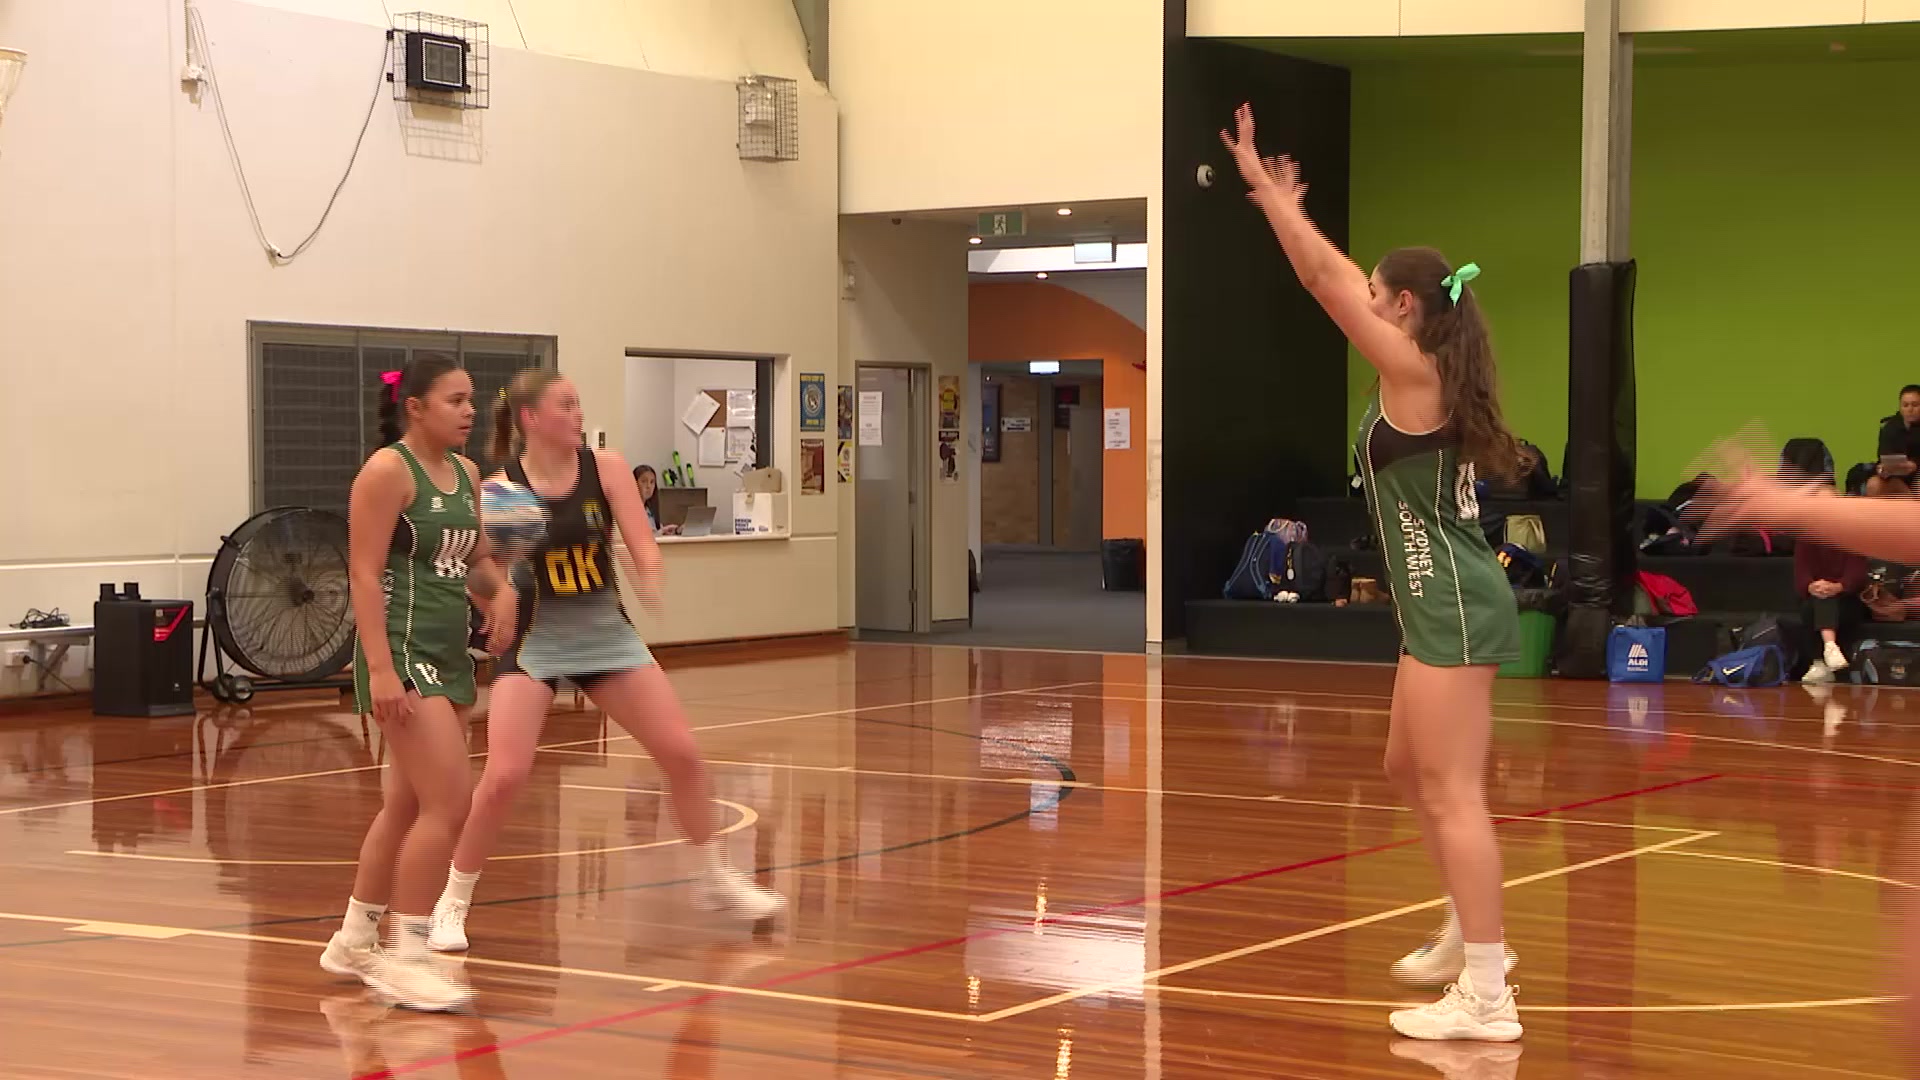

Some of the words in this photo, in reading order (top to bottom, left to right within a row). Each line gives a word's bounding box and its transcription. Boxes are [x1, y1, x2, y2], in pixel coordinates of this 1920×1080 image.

[1398, 500, 1417, 552] SOUTH
[1413, 518, 1434, 579] SYDNEY
[1405, 553, 1423, 598] WEST
[1628, 658, 1648, 666] ALDI
